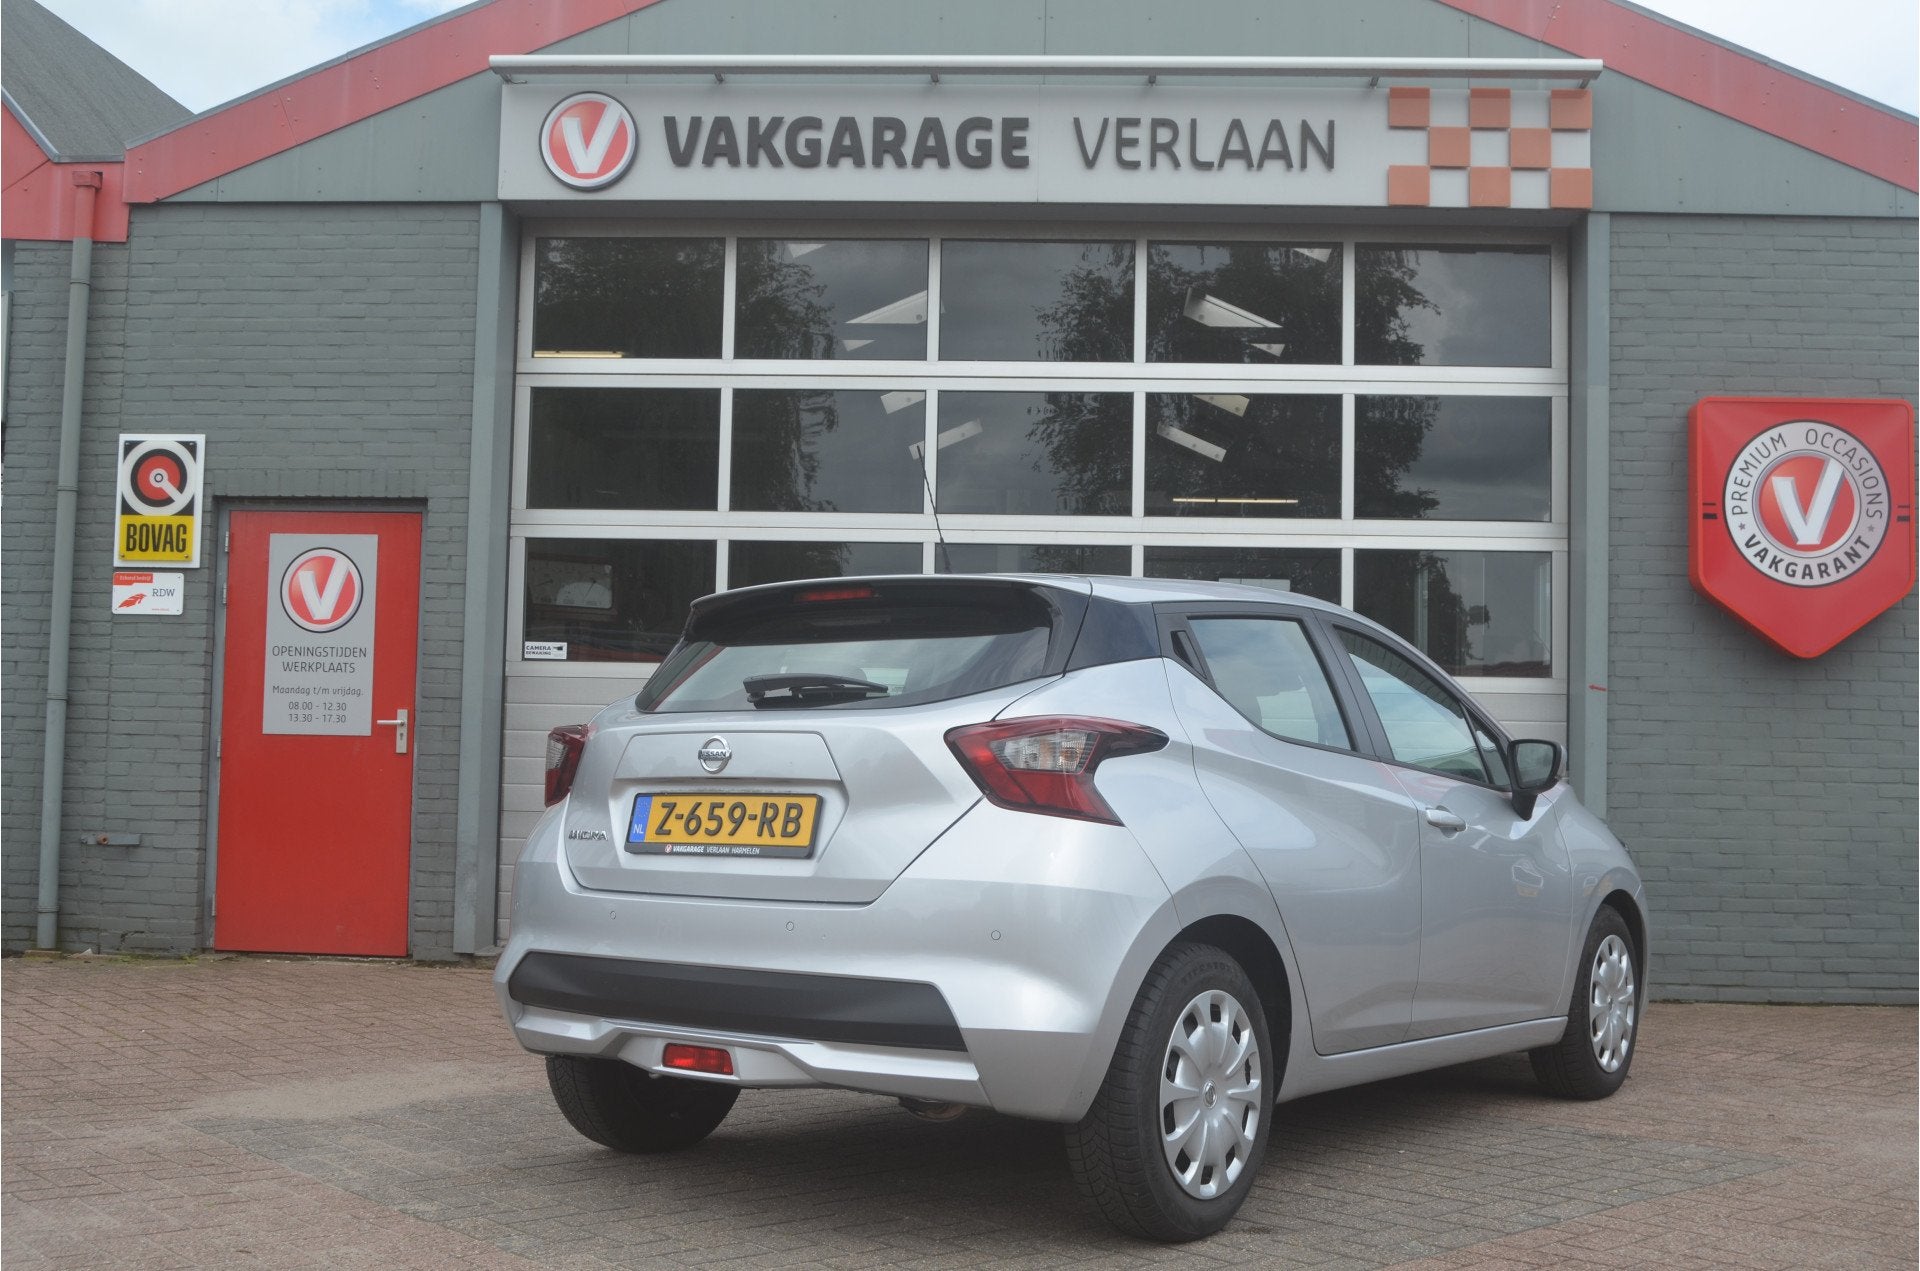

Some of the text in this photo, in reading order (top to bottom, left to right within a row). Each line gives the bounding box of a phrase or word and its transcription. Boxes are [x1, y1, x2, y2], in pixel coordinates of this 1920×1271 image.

[662, 115, 1336, 171] VAKGARAGE VERLAAN
[1731, 428, 1883, 520] PREMIUM OCCASIONS
[125, 522, 188, 554] BOVAG
[1744, 534, 1871, 580] VAKGARANT
[152, 588, 176, 598] RDW
[272, 645, 367, 658] OPENINGSTIJDEN
[282, 661, 355, 674] WERKPLAATS
[272, 685, 311, 696] Maandag
[312, 686, 330, 695] t/m
[288, 701, 313, 711] 08.00
[322, 702, 347, 712] 12.30
[288, 713, 313, 723] 13.30
[322, 714, 347, 724] 17.30
[654, 801, 804, 838] Z-659-RB
[633, 824, 644, 835] NL
[672, 845, 761, 855] VAKGARAGE VERLAAN HARMELEN
